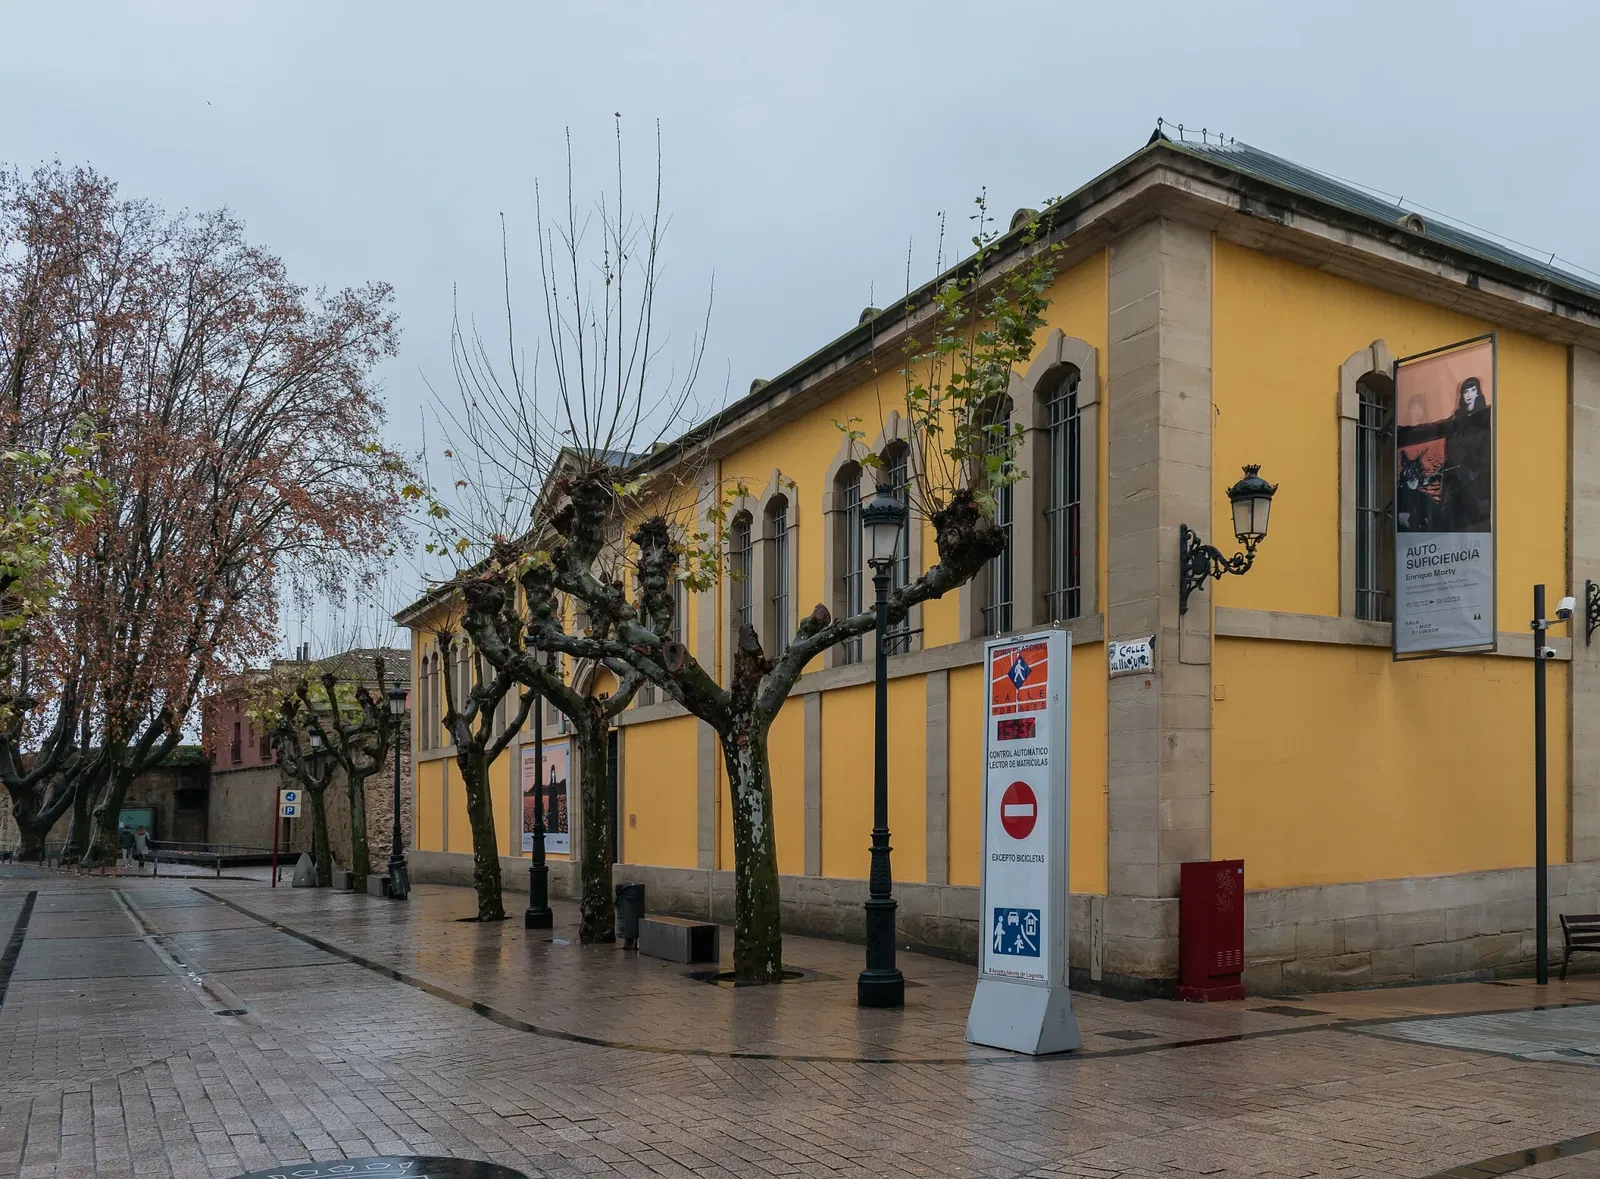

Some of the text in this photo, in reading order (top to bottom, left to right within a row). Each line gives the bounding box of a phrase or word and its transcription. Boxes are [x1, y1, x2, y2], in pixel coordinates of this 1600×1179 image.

[1406, 549, 1480, 569] SUFICIENCIA
[1405, 572, 1432, 581] Enrique
[1433, 569, 1456, 577] Marty
[1119, 644, 1145, 657] CALLE
[994, 688, 1045, 702] CALLE
[993, 702, 1046, 714] PORTALES
[989, 746, 1048, 759] CONTROL AUTOMÁTICO
[989, 757, 1048, 769] LECTOR DE MATRÍCULAS
[991, 853, 1045, 863] EXCEPTO BICICLETAS
